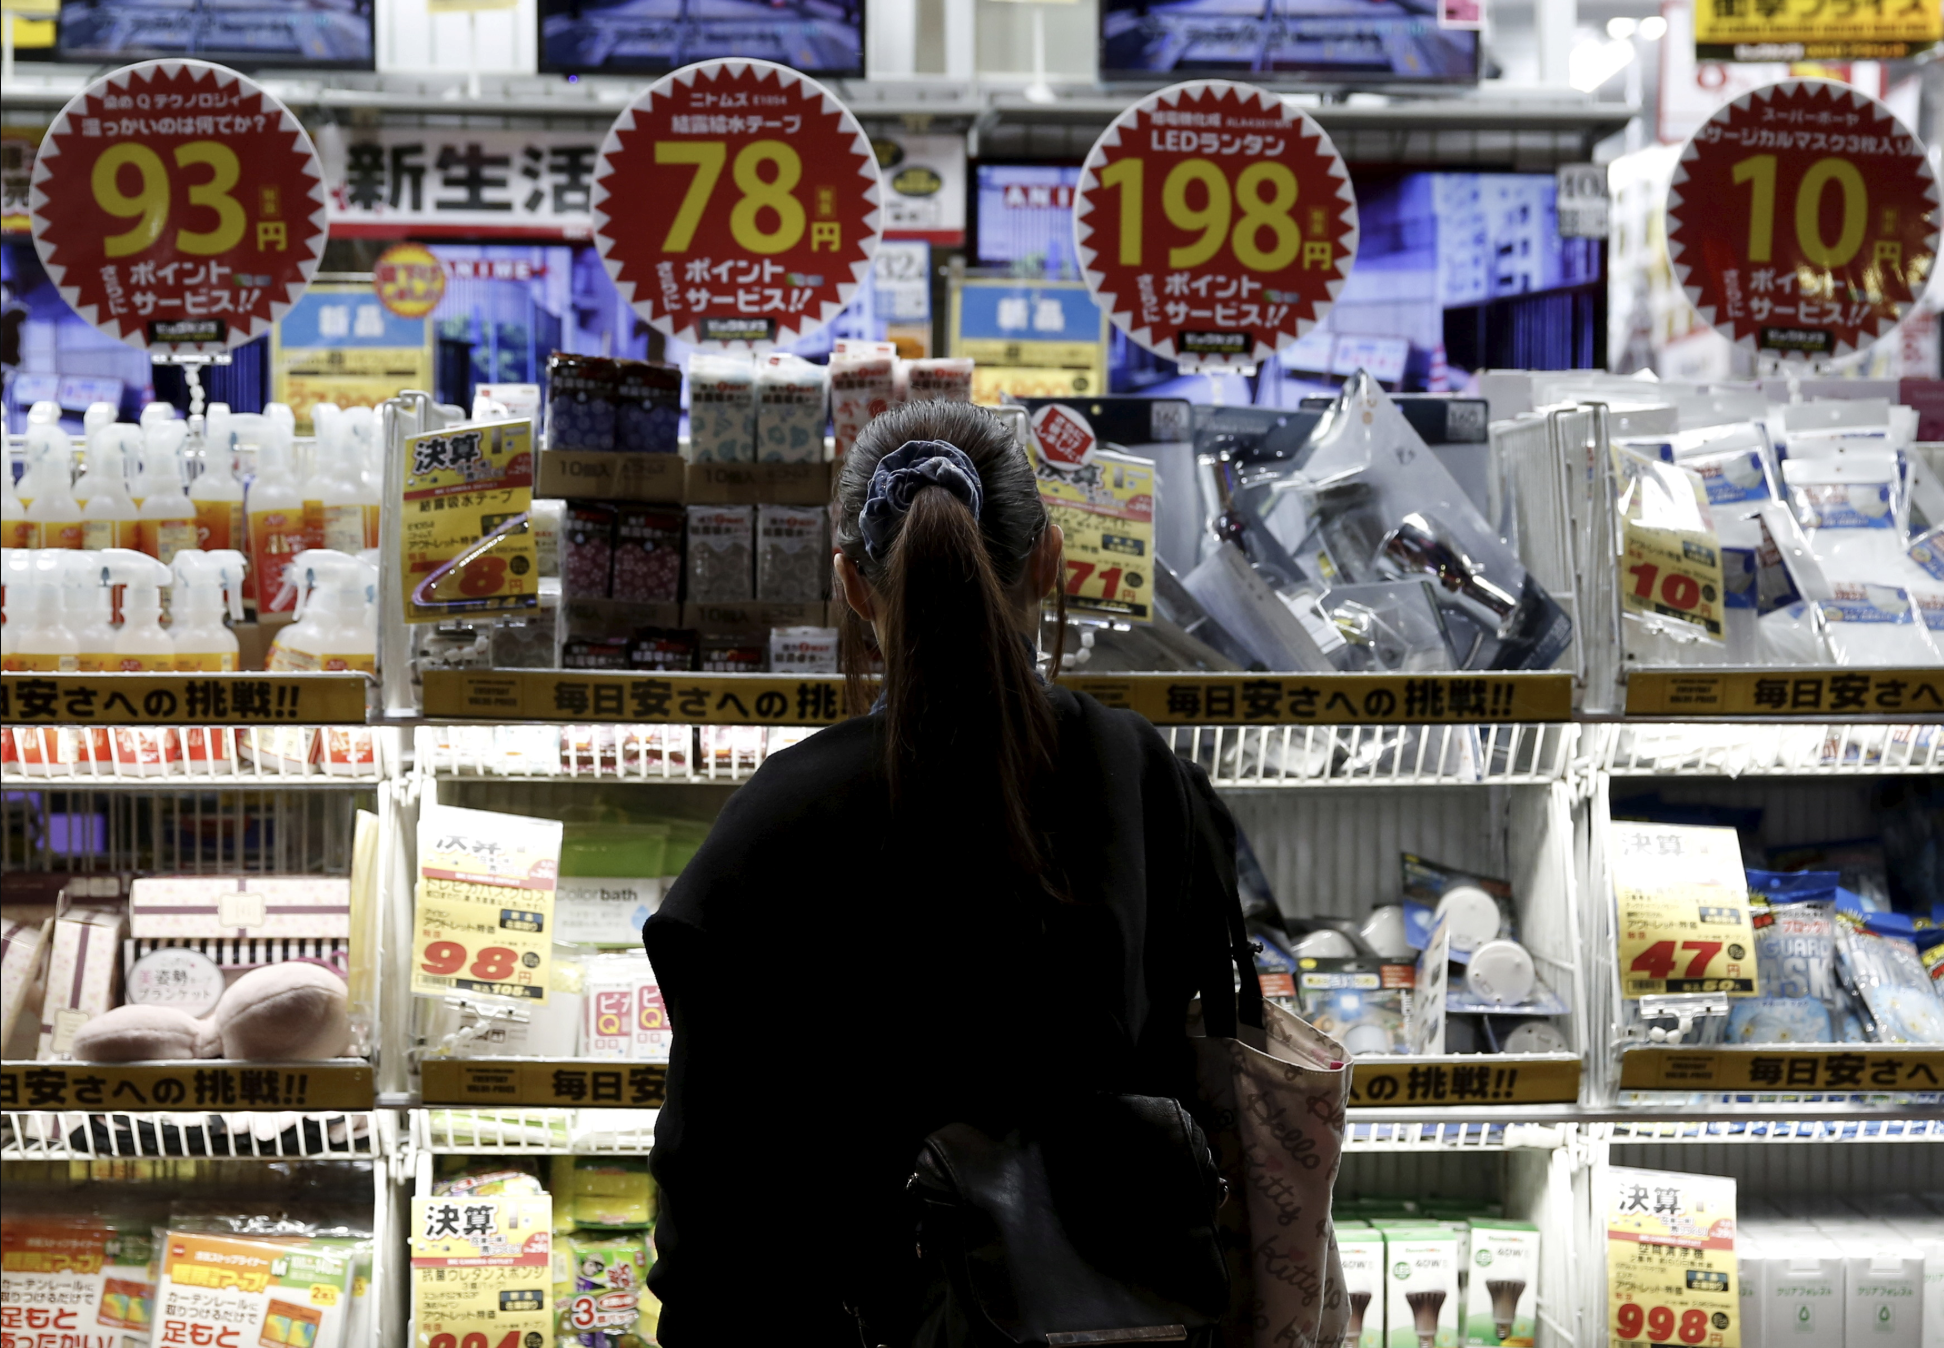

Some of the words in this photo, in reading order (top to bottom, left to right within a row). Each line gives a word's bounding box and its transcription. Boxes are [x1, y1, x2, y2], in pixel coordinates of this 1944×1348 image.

[690, 92, 749, 107] ニトムズ
[1152, 130, 1286, 156] LEDランタン
[346, 142, 597, 213] 新生活
[91, 140, 248, 258] 93
[256, 221, 288, 252] 円
[655, 140, 807, 255] 78
[811, 221, 842, 252] 円
[1101, 158, 1301, 272] 198
[1304, 241, 1333, 271] 円
[1732, 153, 1869, 268] 10
[1874, 241, 1902, 271] 円
[130, 261, 232, 286] ポイント
[684, 257, 785, 283] ポイント
[1164, 271, 1262, 298] ポイント
[131, 288, 262, 315] サービス!!
[684, 286, 813, 313] サービス!!
[1750, 297, 1871, 327] サービス!!
[1164, 300, 1289, 328] サービス!!
[415, 431, 481, 473] 決算
[419, 489, 514, 513] 結露吸水テープ
[509, 578, 524, 594] 円
[1122, 589, 1136, 603] 円
[1629, 562, 1701, 611] 10
[1, 679, 299, 718] 安さへの挑戦!!
[1167, 677, 1516, 719] 毎日安さへの挑戦!!
[1754, 673, 1943, 709] 毎日安さへ
[1621, 833, 1683, 856] 決算
[558, 887, 638, 902] Colorbath
[424, 917, 496, 934] アウトレット特価
[1627, 919, 1698, 930] アウトレット特価
[1630, 941, 1723, 979] 47
[1727, 963, 1741, 978] 円
[1763, 938, 1831, 958] GUARD
[421, 941, 519, 980] 98
[518, 971, 532, 985] 円
[1758, 957, 1833, 999] ASK
[1749, 1052, 1940, 1087] 毎日安さへ
[1619, 1183, 1682, 1215] 決算
[426, 1204, 495, 1236] 決算
[270, 1259, 288, 1277] M
[1, 1291, 95, 1305] 取りつけるだけで
[2, 1278, 94, 1292] カーテンレールに
[1615, 1281, 1683, 1296] アウトレット特価
[1777, 1286, 1833, 1297] クリアフォレスト
[1857, 1286, 1915, 1297] クリアフォレスト
[164, 1303, 260, 1325] 取りつけるだけで
[167, 1291, 260, 1312] カーテンレールに
[574, 1298, 595, 1327] 3
[1, 1307, 78, 1329] 足もと
[423, 1310, 496, 1321] アウトレット特価
[1616, 1303, 1709, 1345] 998
[1710, 1332, 1724, 1347] 円
[161, 1319, 241, 1347] 足もと
